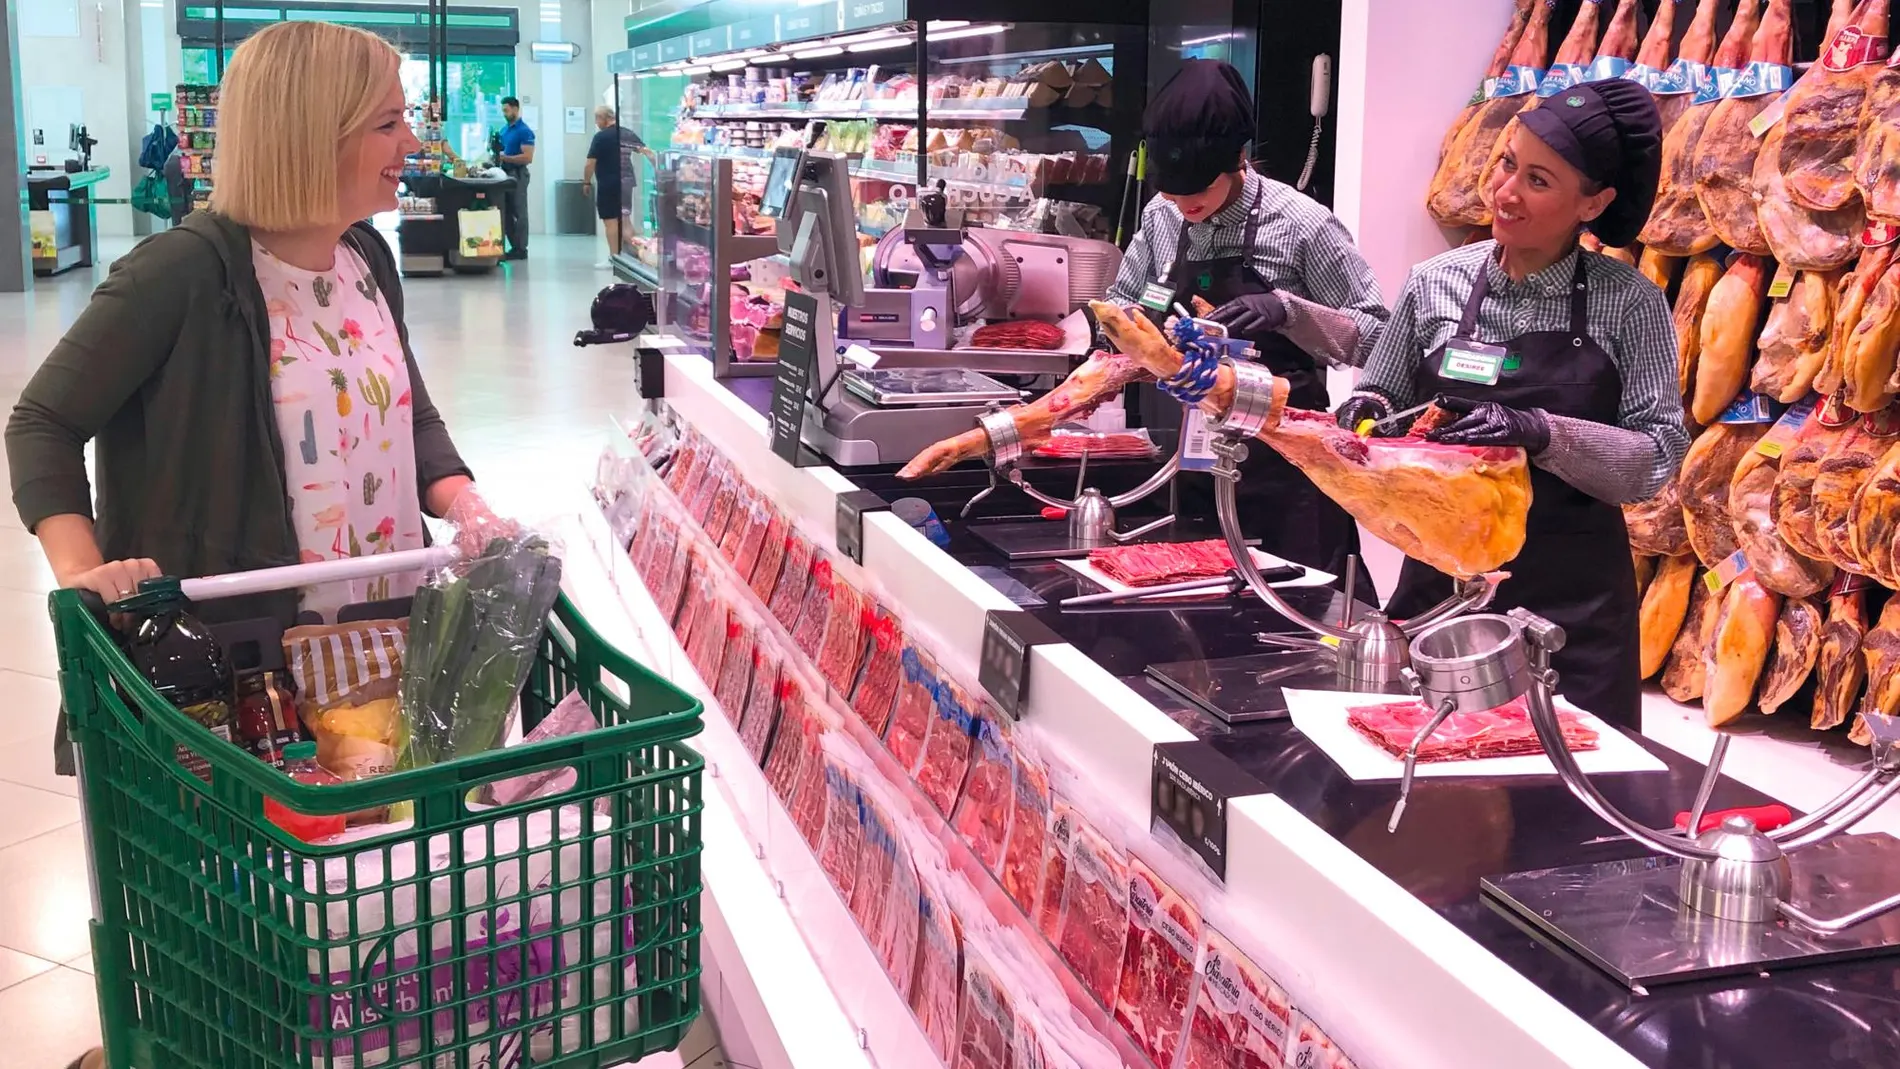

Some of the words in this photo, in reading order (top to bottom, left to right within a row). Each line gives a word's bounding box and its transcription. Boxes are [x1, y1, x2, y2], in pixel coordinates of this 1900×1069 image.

[787, 306, 808, 324] NUESTROS
[785, 323, 806, 341] SERVICIOS
[1178, 769, 1193, 786] CEBO
[1192, 778, 1214, 801] IBÉRICO
[1162, 921, 1176, 936] CEBO
[1175, 932, 1194, 953] IBÉRICO
[1249, 1003, 1264, 1021] CEBO
